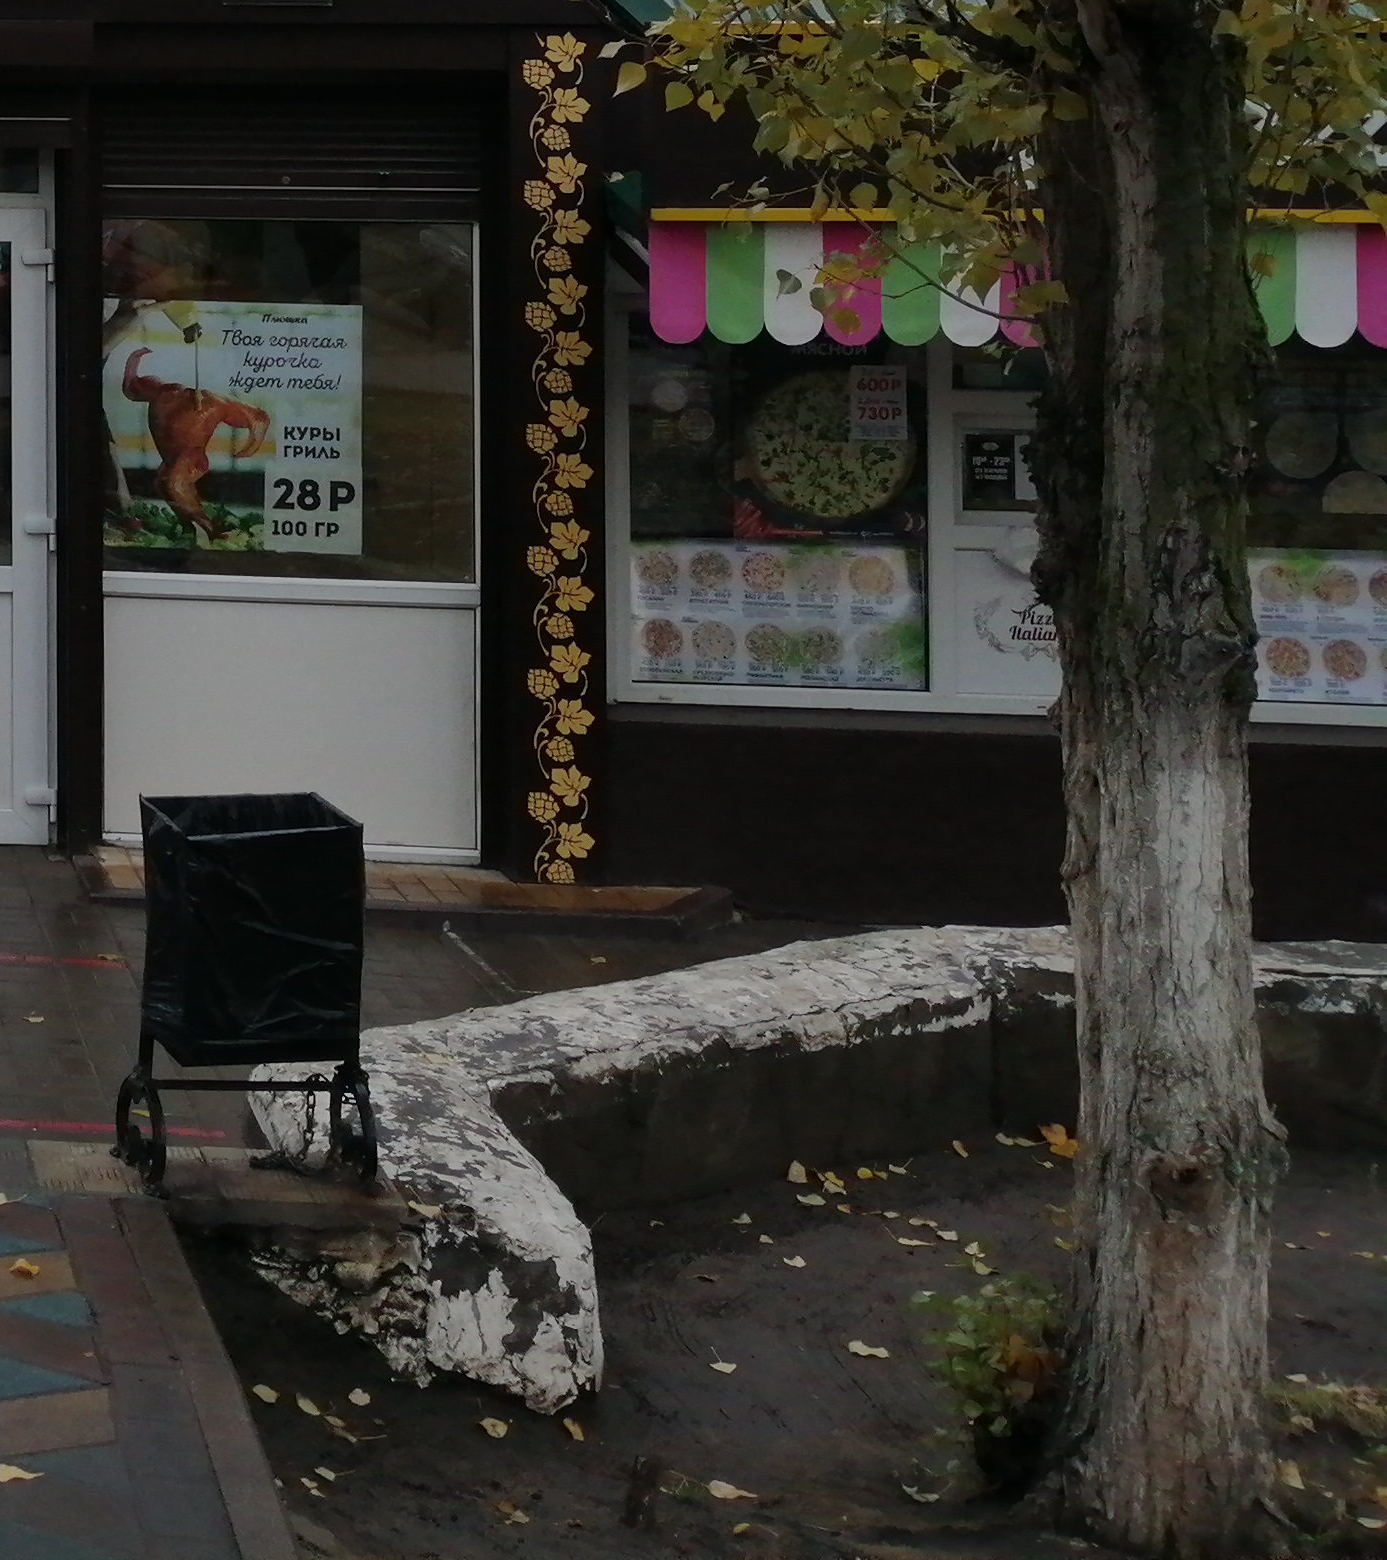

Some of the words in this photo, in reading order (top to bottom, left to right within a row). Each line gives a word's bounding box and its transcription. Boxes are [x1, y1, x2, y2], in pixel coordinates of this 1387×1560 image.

[221, 329, 265, 347] Твоя
[269, 336, 348, 353] горячая
[243, 350, 323, 372] курочка
[228, 371, 283, 393] ждет
[287, 374, 342, 391] тебя!
[283, 425, 341, 441] КУРЫ
[283, 445, 341, 459] ГРИЛЬ
[272, 477, 321, 512] 28
[271, 519, 307, 537] 100
[314, 521, 340, 537] ГР
